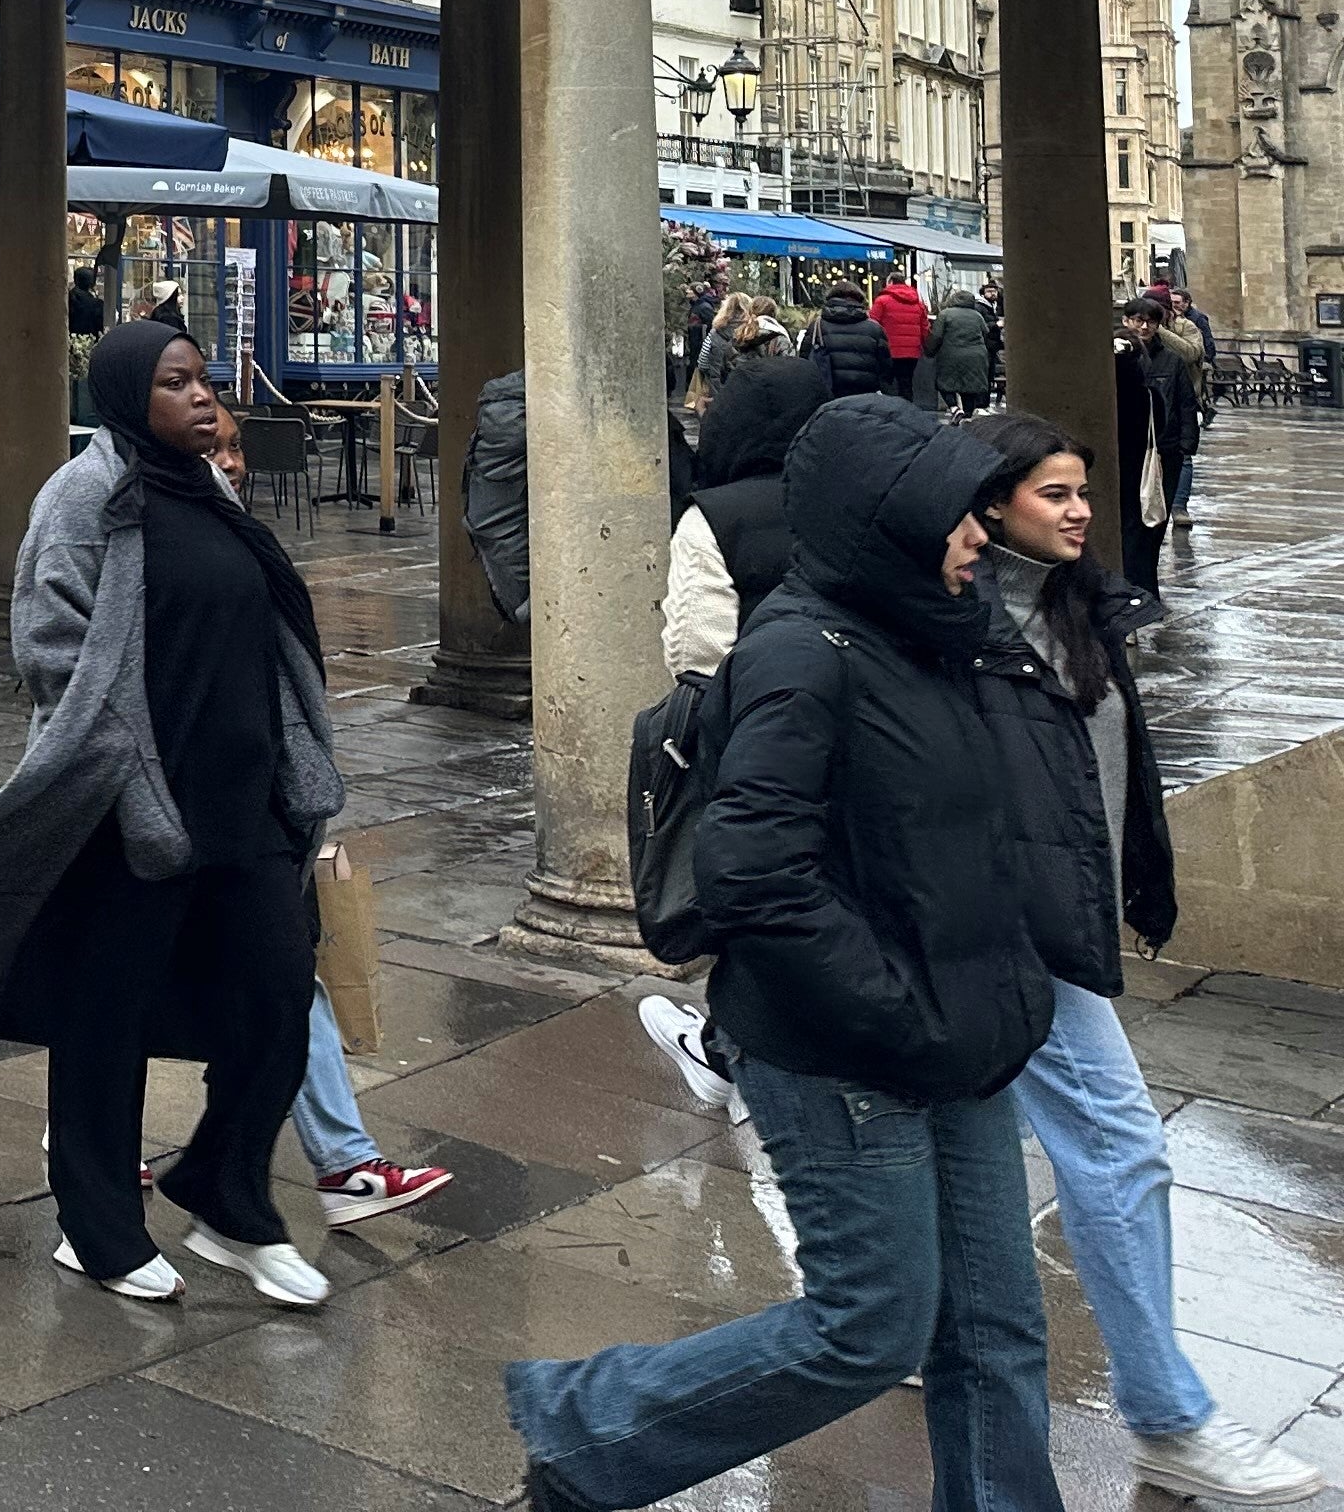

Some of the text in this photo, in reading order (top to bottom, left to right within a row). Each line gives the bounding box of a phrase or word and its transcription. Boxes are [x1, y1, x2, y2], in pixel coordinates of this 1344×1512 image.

[129, 5, 411, 69] JACKS of BATH
[369, 109, 387, 137] of
[174, 181, 246, 195] Cornish Bakery
